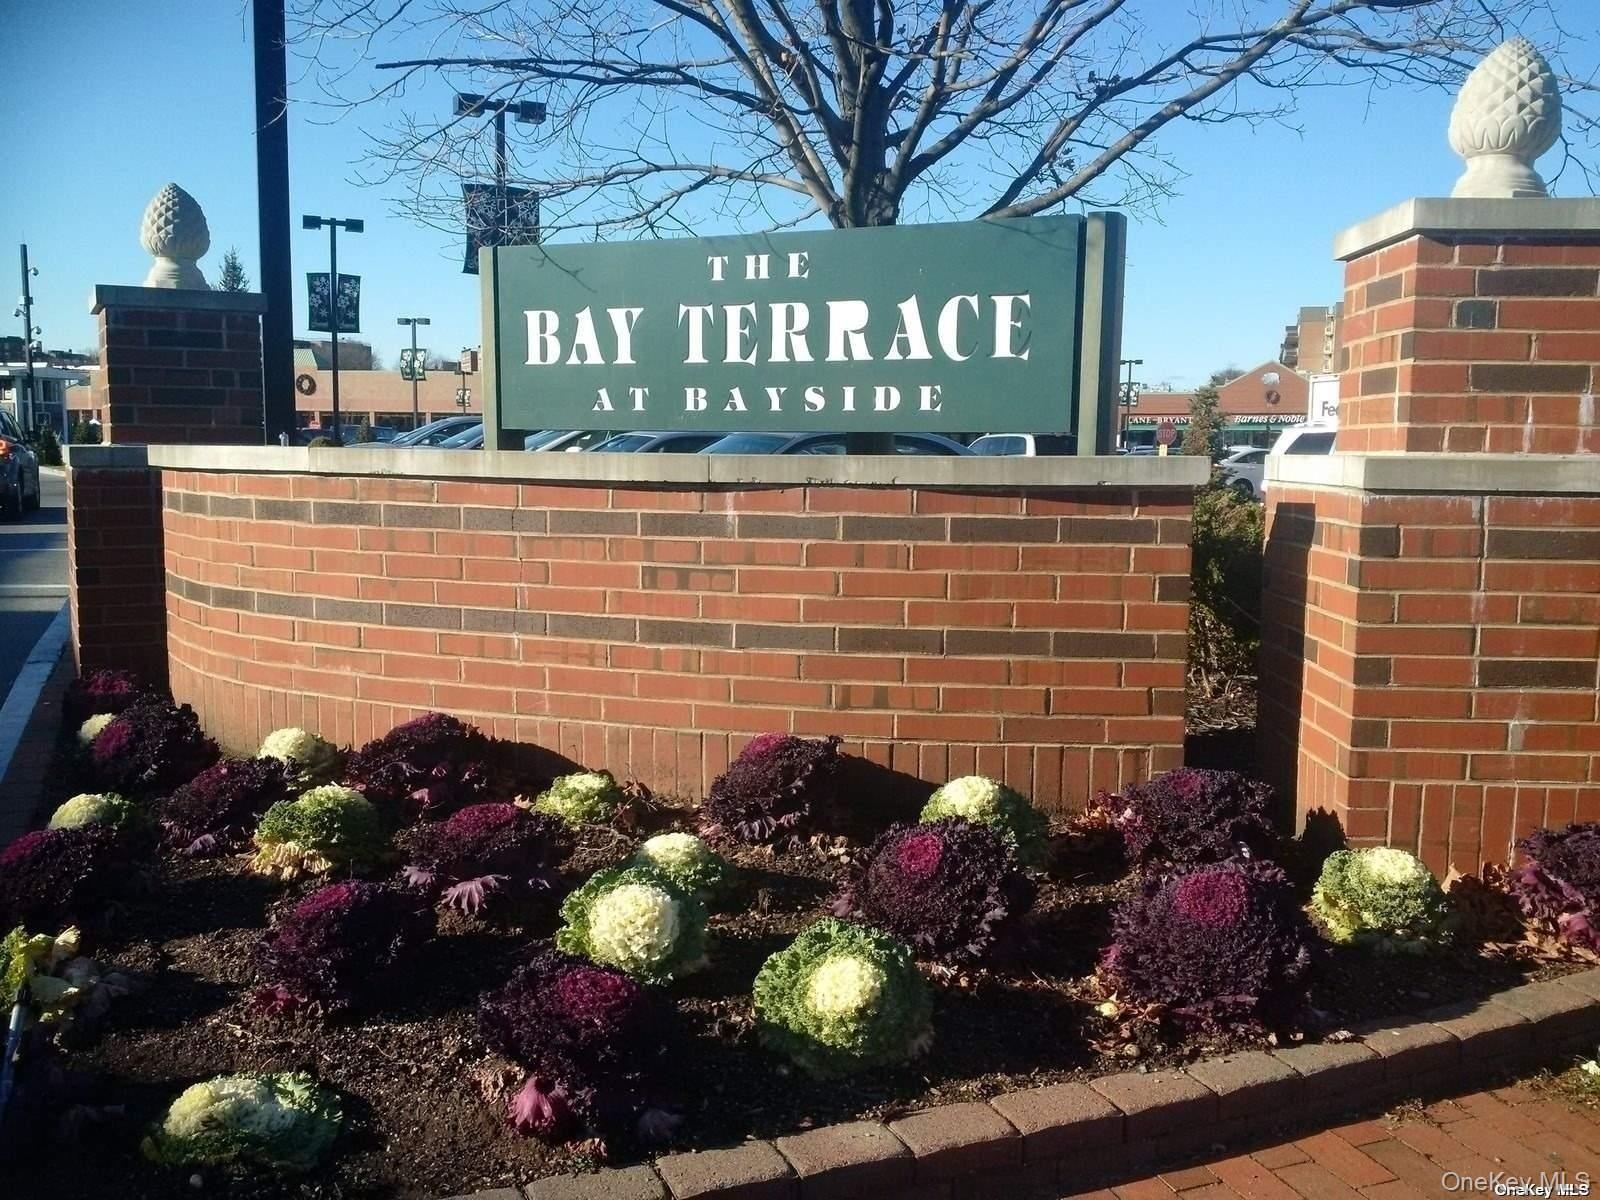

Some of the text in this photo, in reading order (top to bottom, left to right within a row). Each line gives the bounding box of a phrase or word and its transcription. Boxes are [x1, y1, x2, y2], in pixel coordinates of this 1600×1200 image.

[707, 251, 810, 282] THE
[523, 293, 1031, 367] BAY TERRACE
[591, 384, 942, 412] AT BAYSIDE
[1157, 416, 1194, 424] BRYANT
[1234, 414, 1305, 423] Barnes & Noble
[1159, 428, 1176, 438] STOP
